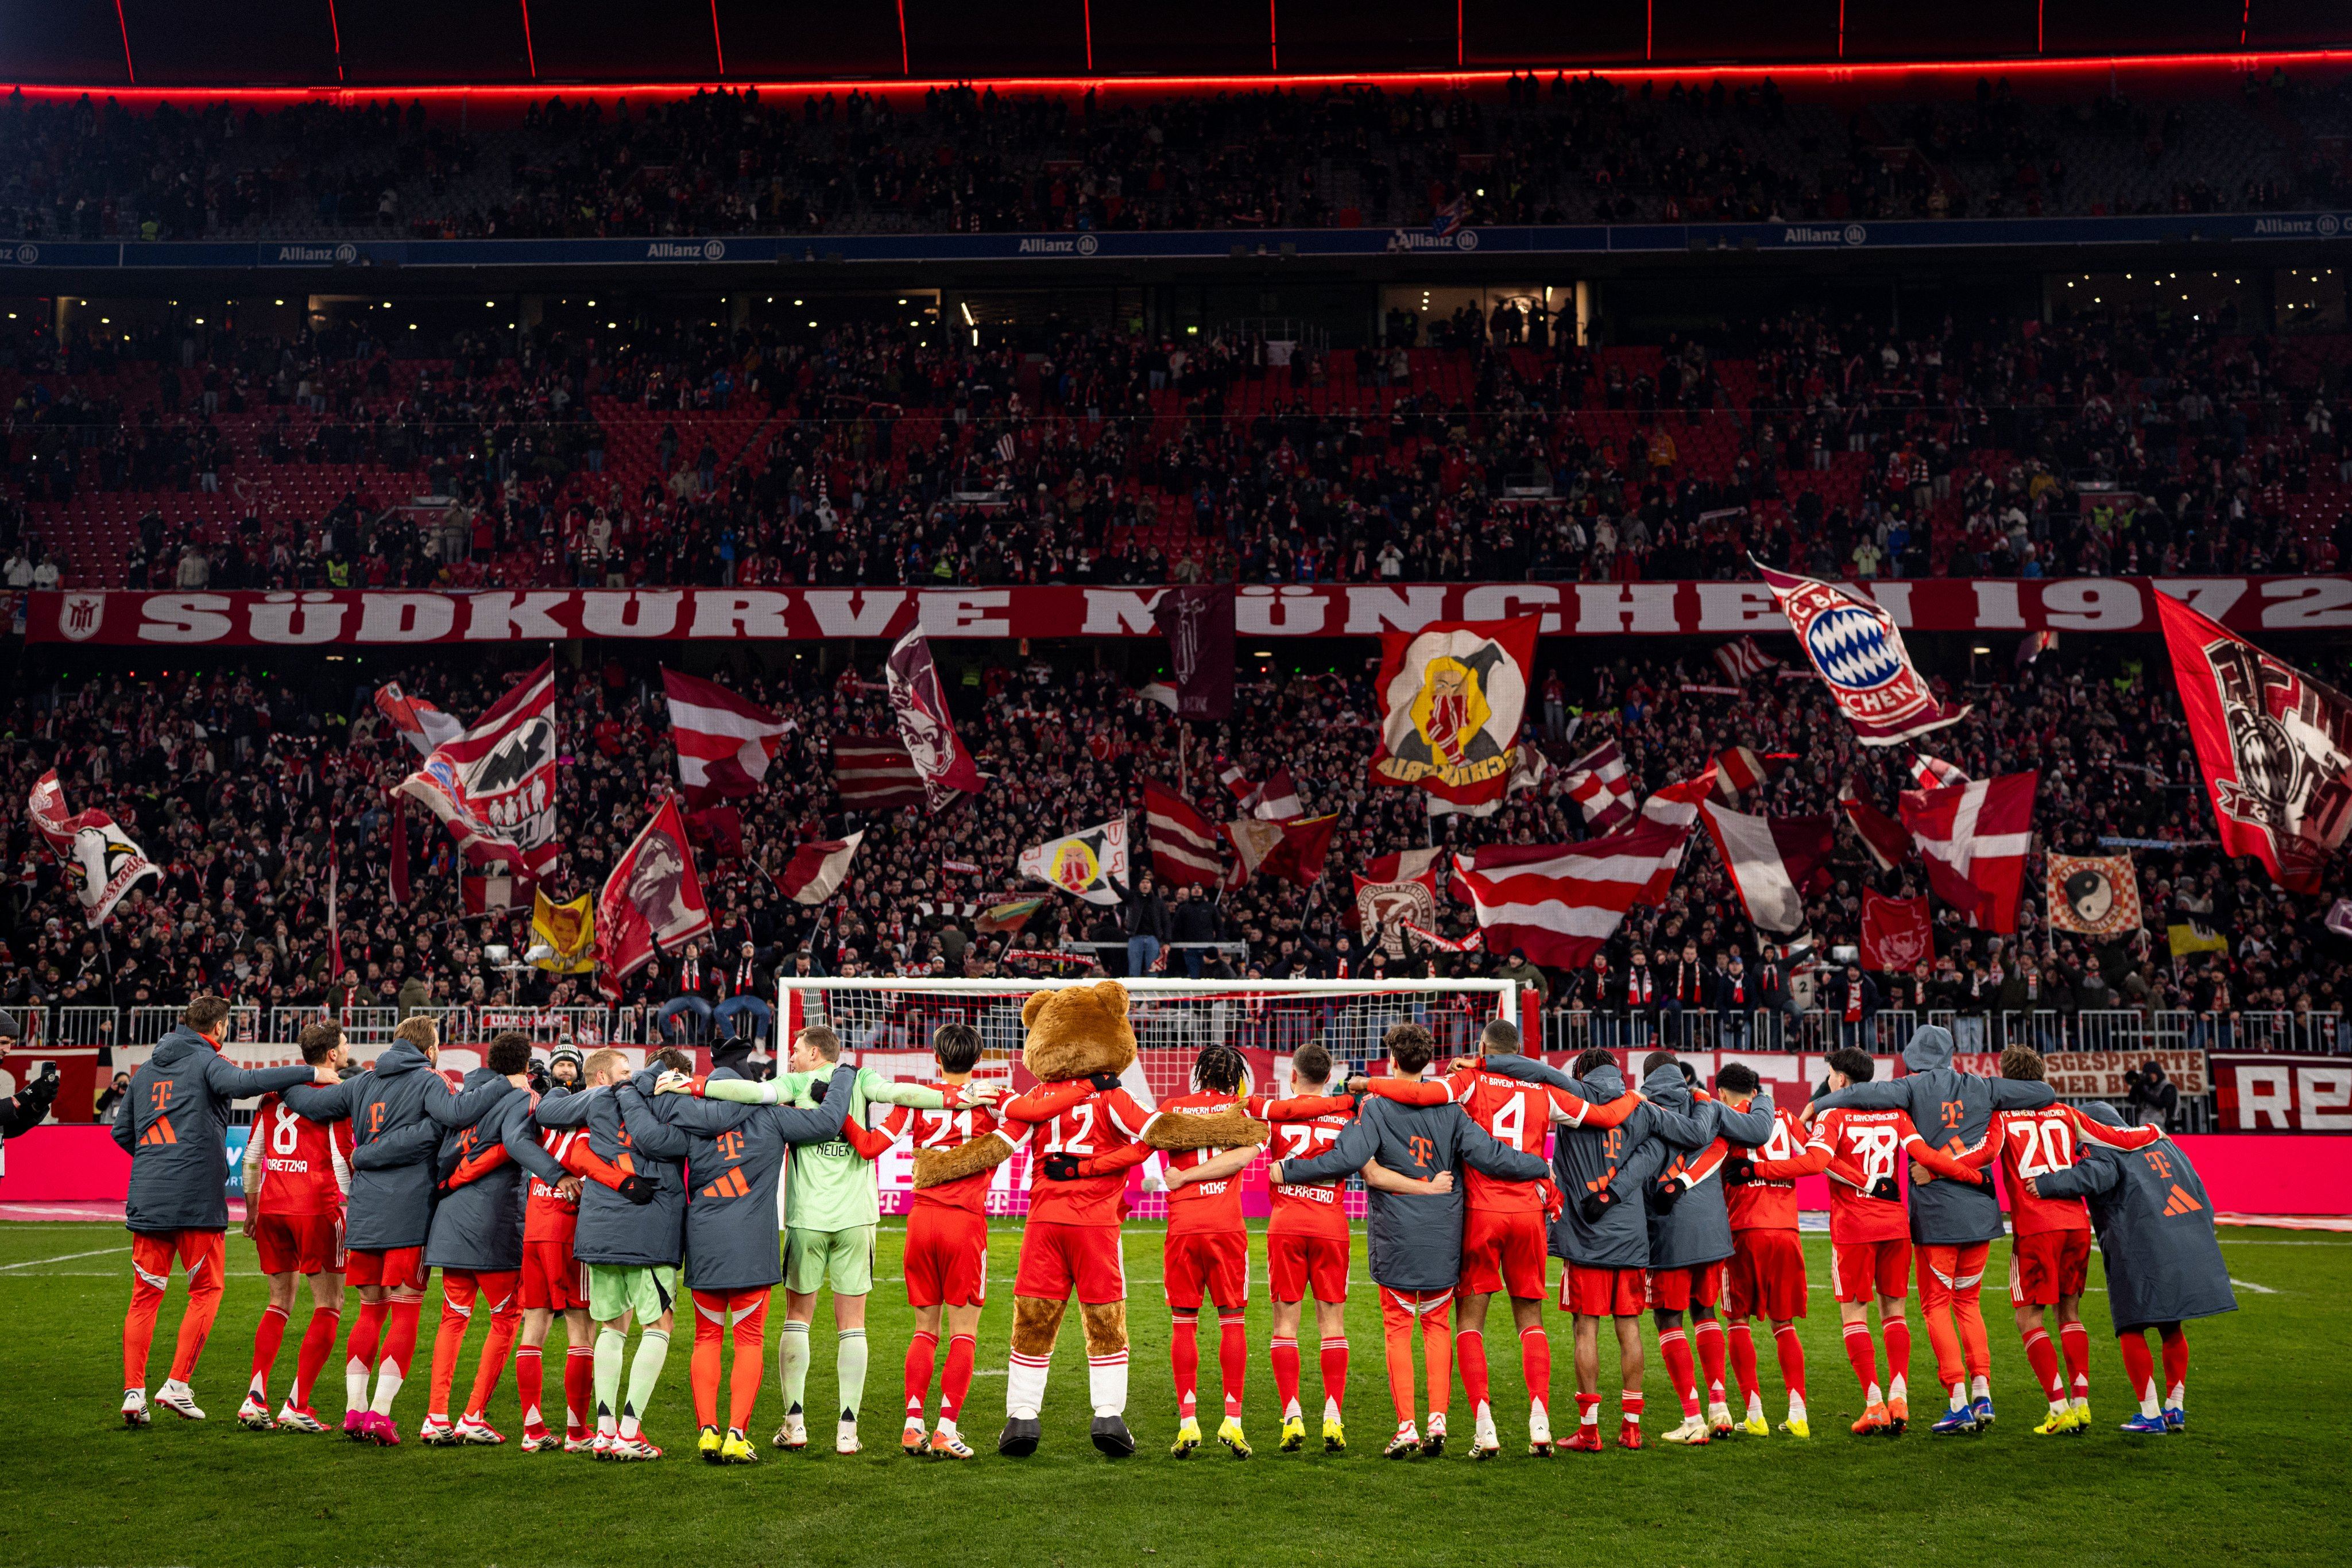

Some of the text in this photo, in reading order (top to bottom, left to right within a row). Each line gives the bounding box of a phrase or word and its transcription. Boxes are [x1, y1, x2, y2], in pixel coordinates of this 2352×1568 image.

[2254, 219, 2312, 233] Allianz
[1398, 233, 1453, 247] Allianz
[1784, 228, 1840, 242] Allianz
[647, 243, 701, 257] Allianz
[1019, 238, 1074, 252] Allianz
[278, 247, 332, 260] Allianz
[137, 590, 1011, 644] SÜDKURVE
[1971, 578, 2352, 630] 1972
[1846, 680, 1915, 713] CHEN
[1799, 981, 1808, 993] 2
[2046, 1051, 2202, 1072] SGESPERRTE
[1480, 1074, 1488, 1083] FC
[1489, 1077, 1514, 1089] BAYERN
[1182, 1106, 1209, 1114] BAYERN
[2011, 1109, 2036, 1117] BAYERN
[273, 1101, 300, 1155] 8
[1492, 1091, 1525, 1151] 4
[921, 1108, 973, 1152] 21
[1043, 1104, 1094, 1154] 12
[817, 1143, 850, 1157] NEUER
[2007, 1120, 2072, 1179] 20
[532, 1183, 553, 1198] LAIM
[1278, 1184, 1334, 1204] GUERREIRO
